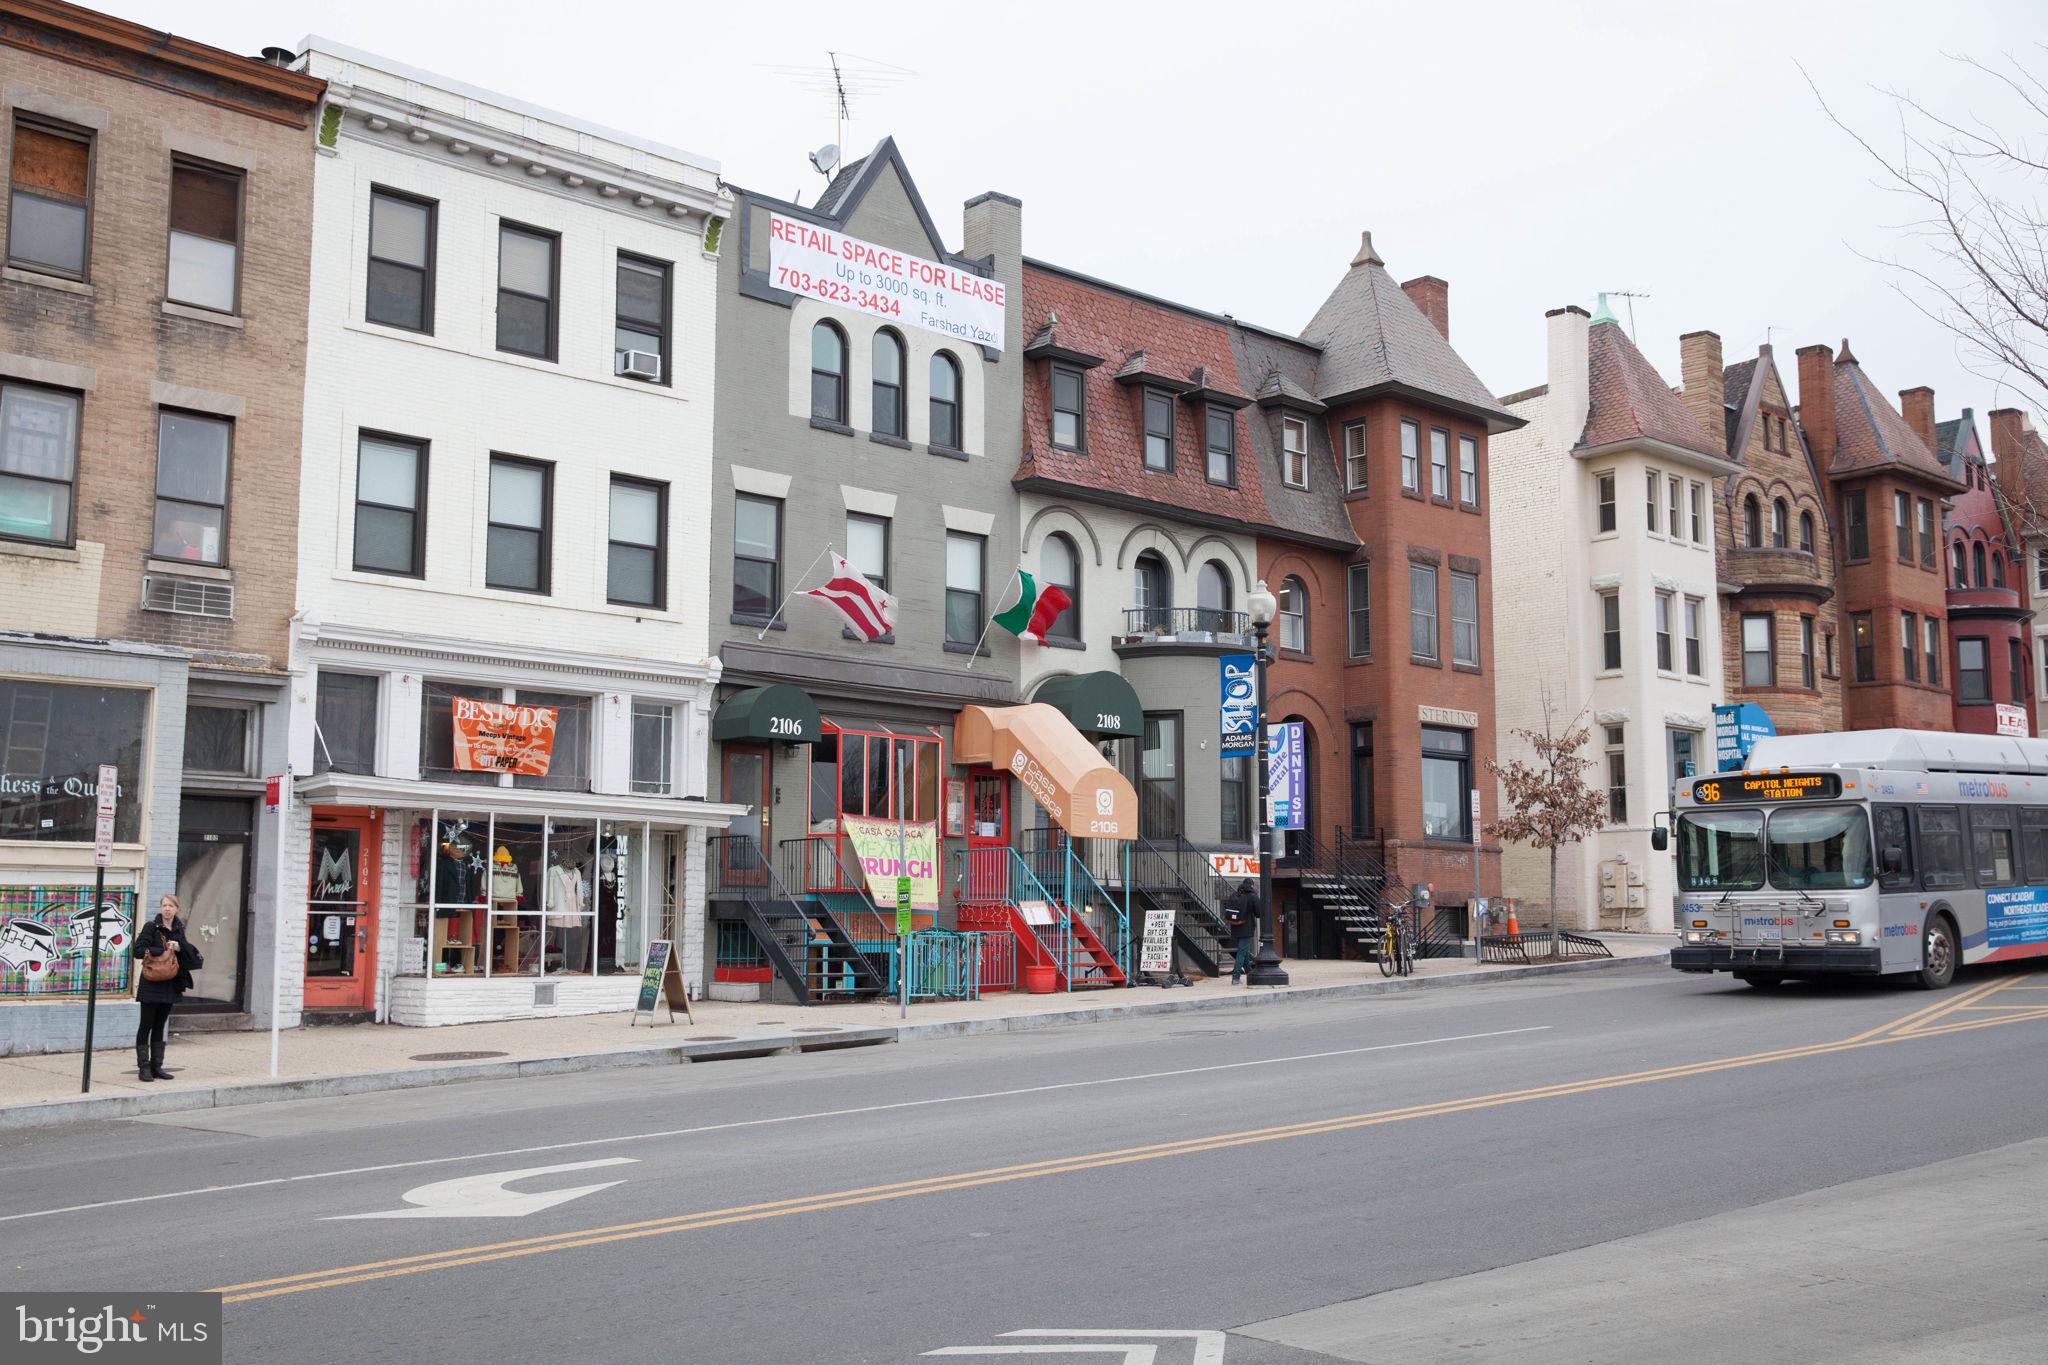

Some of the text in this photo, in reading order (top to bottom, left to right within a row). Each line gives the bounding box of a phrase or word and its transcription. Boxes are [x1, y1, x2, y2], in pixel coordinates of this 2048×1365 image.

[770, 218, 1005, 307] RETAIL SPACE FOR LEASE
[778, 266, 901, 317] 703-623-3434
[835, 261, 947, 308] Up to 3000 sq. ft.
[921, 311, 968, 336] Farshad
[1224, 664, 1254, 733] SHOP
[456, 699, 504, 724] BEST
[505, 706, 522, 725] of
[1096, 712, 1121, 730] 2108
[1421, 707, 1477, 726] STERLING
[769, 715, 803, 736] 2106
[478, 730, 527, 741] Meeps Vintage
[1224, 734, 1253, 743] ADAMS
[1221, 741, 1255, 749] MORGAN
[1028, 759, 1056, 796] Casa
[1290, 726, 1302, 825] DENTIST
[1743, 776, 1822, 790] CAPITOL HEIGHTS
[46, 785, 59, 795] the
[1023, 770, 1063, 818] Oaxaca
[1763, 788, 1803, 798] STATION
[1958, 778, 2009, 798] metrobus
[858, 826, 883, 837] CASA
[884, 828, 923, 839] OAACA
[1090, 820, 1118, 833] 2106
[361, 847, 370, 886] 2104
[1681, 903, 1700, 912] 2453
[1987, 893, 2011, 904] CONNECT
[1744, 916, 1794, 926] metrobus
[1884, 922, 1919, 937] metrobus
